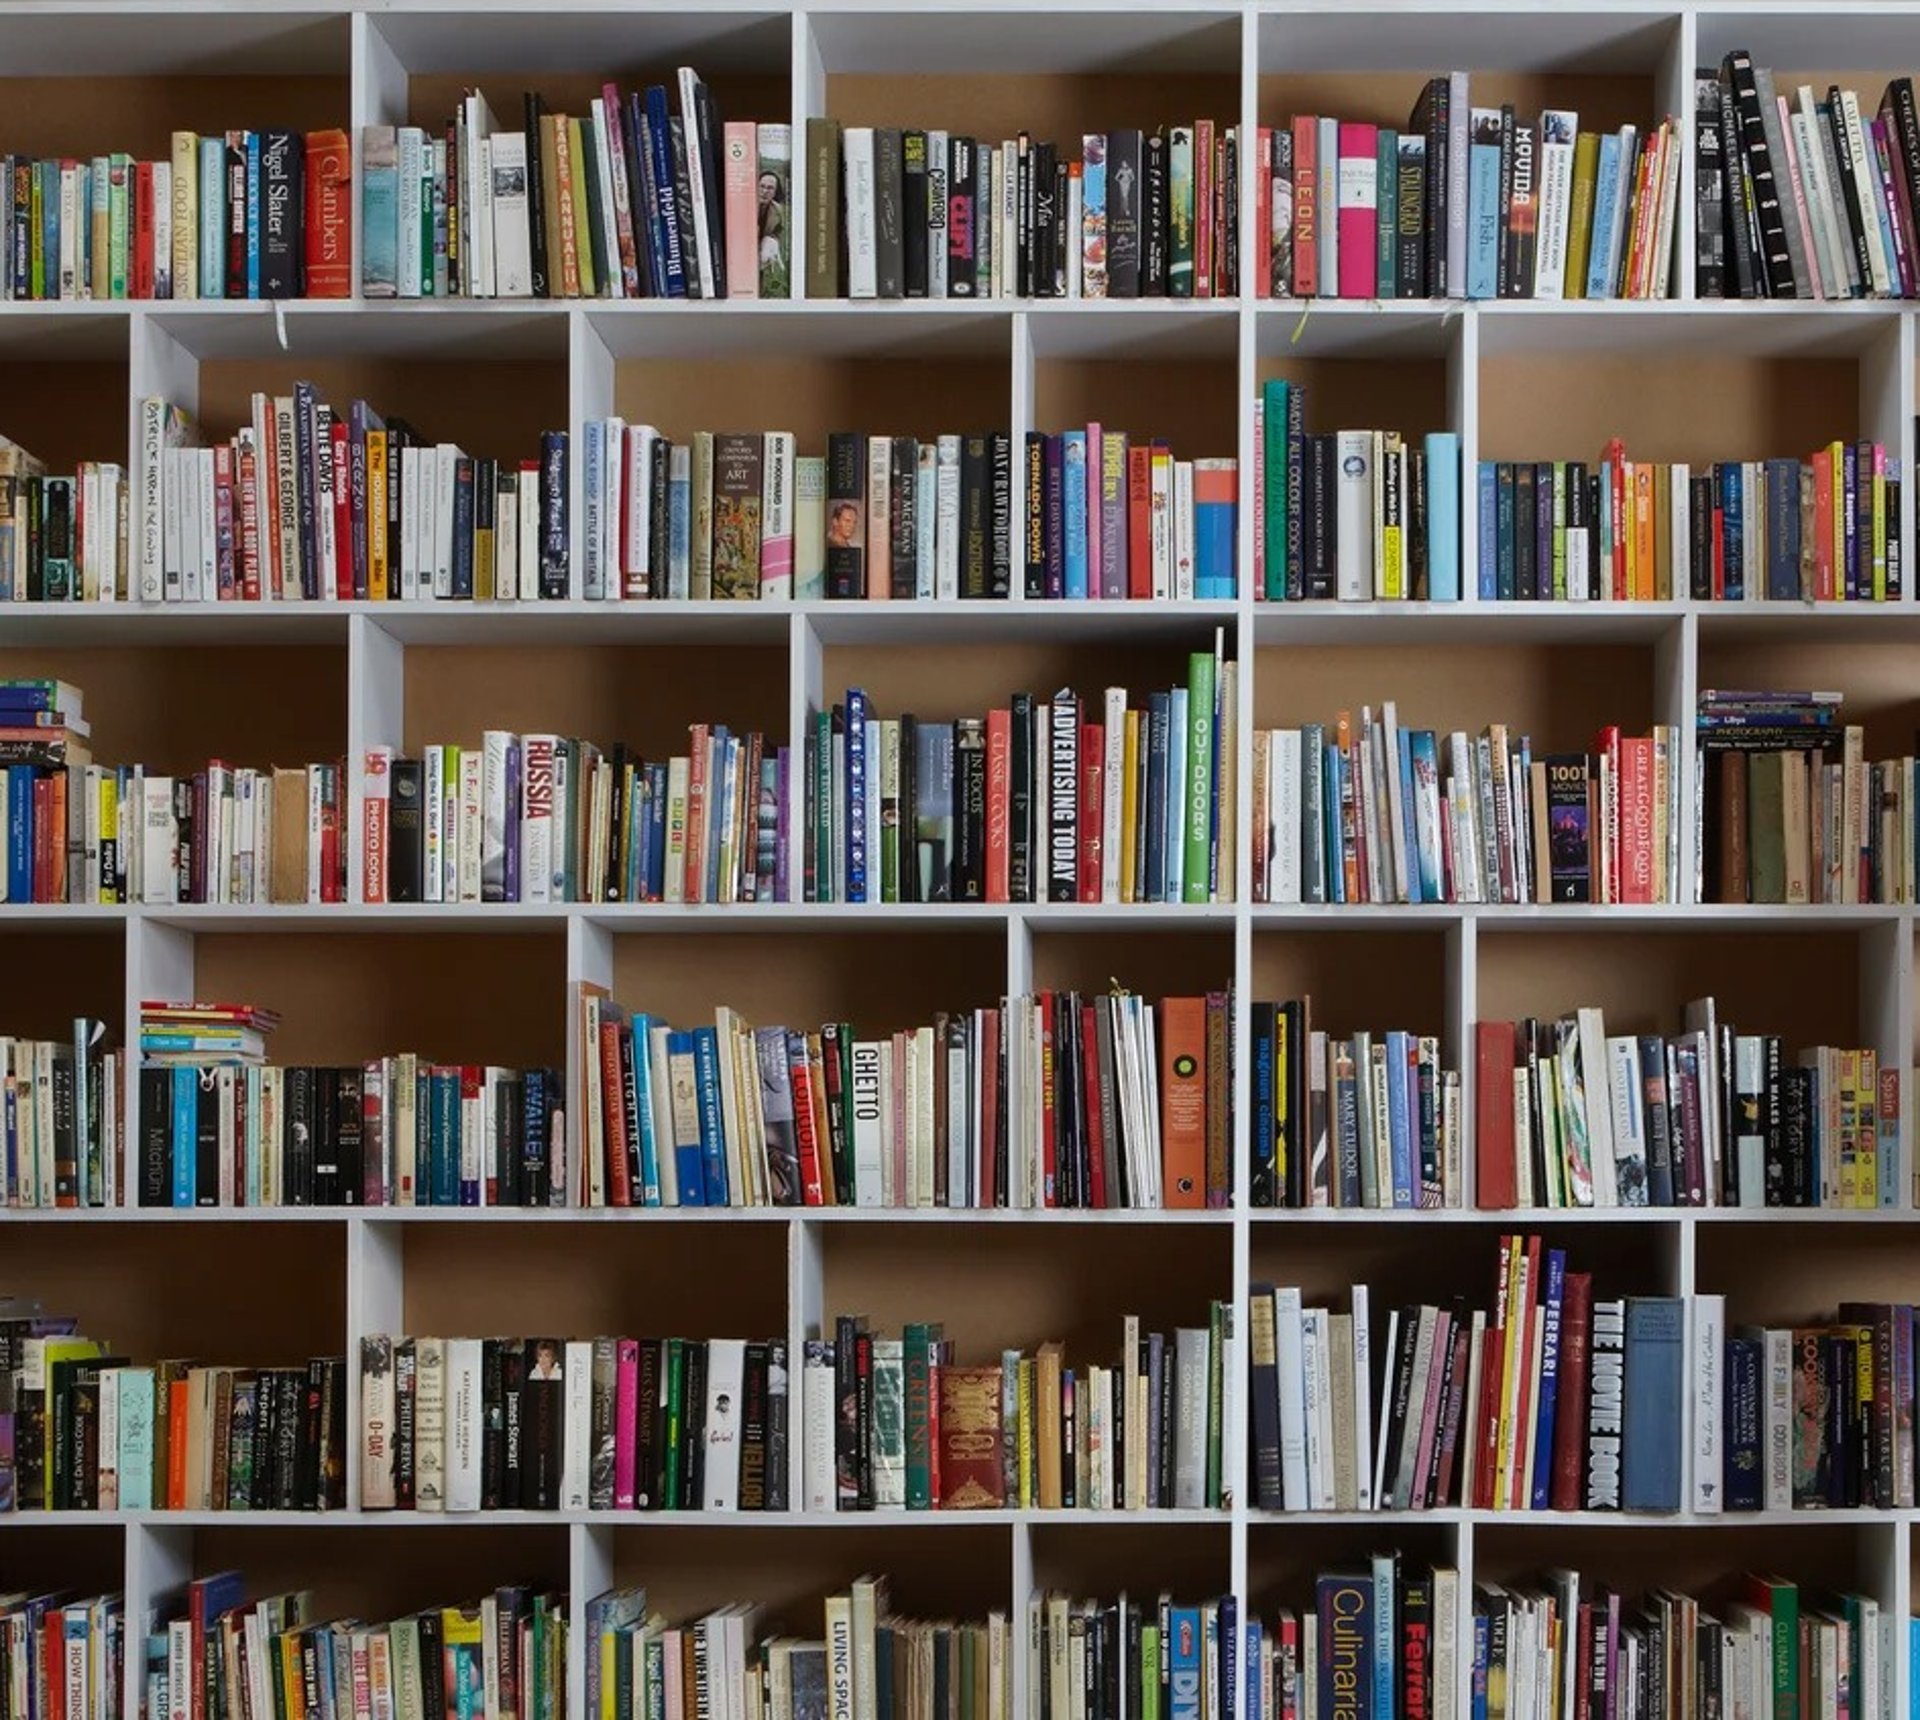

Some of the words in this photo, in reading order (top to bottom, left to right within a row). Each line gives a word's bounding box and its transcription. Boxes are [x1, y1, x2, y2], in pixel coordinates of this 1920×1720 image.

[1901, 90, 1916, 149] CHEESES
[249, 149, 257, 173] THE
[264, 134, 287, 180] Nigel
[556, 116, 570, 182] EAGLE
[1453, 126, 1465, 173] London
[1514, 128, 1532, 205] MOVIDA
[1721, 94, 1736, 154] MICHAEL
[1729, 157, 1742, 203] KENNA
[1908, 153, 1919, 173] OF
[176, 176, 189, 222] FOOD
[249, 174, 257, 202] BOOK
[322, 156, 341, 260] Chambers
[423, 183, 432, 213] Kosovo
[928, 169, 945, 229] CRAWFORD
[1037, 191, 1053, 227] Mia
[1297, 169, 1313, 241] LEON
[1400, 167, 1421, 235] STALINGRAD
[1453, 177, 1465, 228] Interiors
[249, 204, 257, 220] OF
[268, 185, 287, 234] Slater
[560, 189, 576, 266] ANNUAL
[951, 196, 967, 259] CLIFT
[1479, 214, 1499, 245] Fish
[249, 226, 257, 257] YOGA
[660, 187, 682, 276] Blumenfeld
[176, 226, 190, 294] SICILIAN
[146, 401, 160, 461] PATRICK
[317, 411, 332, 449] BETTE
[1288, 388, 1302, 436] HAMLYN
[278, 412, 291, 464] GILBERT
[333, 440, 347, 464] Gary
[586, 427, 598, 468] PATRICK
[773, 437, 783, 455] BOB
[994, 436, 1009, 467] JOAN
[1289, 441, 1302, 462] ALL
[280, 468, 292, 479] &
[318, 453, 332, 493] DAVIS
[352, 443, 364, 511] BARNS
[372, 451, 382, 469] The
[726, 469, 749, 480] ART
[1031, 442, 1040, 513] TORNADO
[1103, 435, 1117, 502] HEPBURN
[1387, 453, 1397, 484] Building
[1844, 455, 1855, 491] Beggars'
[146, 465, 160, 507] HERON
[336, 467, 348, 504] Rhodes
[588, 469, 598, 500] BISHOP
[773, 458, 783, 505] WOODWARD
[1050, 467, 1059, 498] BETTE
[1289, 465, 1301, 515] COLOUR
[1388, 494, 1396, 510] Web
[243, 499, 256, 528] YORK
[281, 481, 294, 530] GEORGE
[373, 472, 383, 557] HOUSEBUILDER'S
[588, 505, 598, 534] BATTLE
[992, 470, 1009, 540] CRAWFORD
[1050, 501, 1059, 532] DAVIS
[1388, 510, 1397, 526] Site
[1845, 493, 1855, 535] Banquets
[243, 530, 256, 555] BODY
[588, 536, 598, 548] OF
[1031, 517, 1040, 563] DOWN
[1050, 535, 1059, 572] SPEAKS
[1104, 505, 1115, 573] EDWARDS
[1288, 520, 1300, 554] COOK
[1888, 539, 1898, 557] POINT
[244, 558, 256, 581] PLAN
[588, 550, 598, 585] BRITAIN
[820, 724, 831, 769] LONDON
[970, 753, 983, 768] IN
[991, 732, 1004, 789] CLASSIC
[1052, 706, 1076, 818] ADVERTISING
[527, 740, 552, 819] RUSSIA
[970, 772, 983, 813] FOCUS
[1193, 718, 1209, 842] OUTDOORS
[1550, 766, 1586, 780] 1001
[822, 774, 831, 828] REVEALED
[991, 793, 1004, 848] COOKS
[368, 800, 380, 850] PHOTO
[103, 843, 113, 870] Doku
[368, 852, 380, 897] ICONS
[1052, 826, 1076, 882] TODAY
[103, 872, 113, 885] Su
[701, 1037, 710, 1053] THE
[1769, 1040, 1778, 1079] REBEL
[703, 1056, 712, 1078] RIVER
[854, 1049, 880, 1120] GHETTO
[1257, 1037, 1270, 1098] magnum
[1376, 1068, 1386, 1088] what
[1787, 1078, 1796, 1094] MY
[622, 1072, 638, 1154] LIGHTING
[1342, 1090, 1356, 1128] MARY
[1377, 1090, 1386, 1106] not
[1770, 1084, 1778, 1125] MALES
[1883, 1074, 1896, 1113] Spain
[707, 1104, 716, 1127] COOK
[794, 1074, 816, 1159] London
[1259, 1104, 1271, 1157] cinema
[1379, 1119, 1387, 1141] wear
[1788, 1106, 1797, 1154] STORY
[148, 1129, 164, 1196] Mitchum
[709, 1130, 717, 1154] BOOK
[1344, 1131, 1358, 1178] TUDOR
[1354, 1328, 1368, 1362] Dubai
[1542, 1299, 1561, 1377] FERRARI
[1591, 1299, 1625, 1350] THE
[641, 1347, 655, 1384] JAMES
[1859, 1344, 1872, 1401] WATCHMEN
[1880, 1321, 1889, 1393] CROATIA
[157, 1381, 166, 1415] SONTAG
[257, 1376, 270, 1429] sleepers
[279, 1380, 292, 1401] MY
[461, 1370, 470, 1423] KATHARINE
[507, 1392, 519, 1425] James
[1181, 1363, 1191, 1430] COOKBOOK
[1589, 1356, 1625, 1434] MOVIE
[1774, 1368, 1786, 1410] FAMILY
[1881, 1402, 1889, 1417] AT
[279, 1407, 291, 1457] STORY
[400, 1398, 412, 1438] PHILIP
[641, 1388, 653, 1445] STEWART
[368, 1421, 384, 1458] D-DAY
[400, 1441, 412, 1478] REEVE
[461, 1426, 469, 1470] HEPBURN
[508, 1426, 519, 1468] Stewart
[1773, 1424, 1787, 1488] COOKBOOK
[1881, 1428, 1890, 1473] TABLE
[743, 1443, 762, 1507] ROTTEN
[1588, 1438, 1624, 1508] BOOK
[1379, 1576, 1388, 1634] AUSTRALIA
[399, 1629, 412, 1661] ROSE
[498, 1610, 513, 1676] HILLERMAN
[694, 1623, 707, 1644] THE
[834, 1622, 847, 1674] LIVING
[1246, 1635, 1260, 1666] nobu
[1380, 1637, 1389, 1658] THE
[1491, 1614, 1504, 1658] VOGUE
[70, 1646, 82, 1673] HOW
[304, 1648, 316, 1681] thirsty
[646, 1646, 663, 1681] Nigel
[1227, 1627, 1235, 1713] WIZARDOLOGY
[1777, 1622, 1789, 1688] CULINARIA
[307, 1683, 317, 1706] work
[648, 1683, 664, 1719] Slater
[696, 1648, 708, 1715] TWENTIETH
